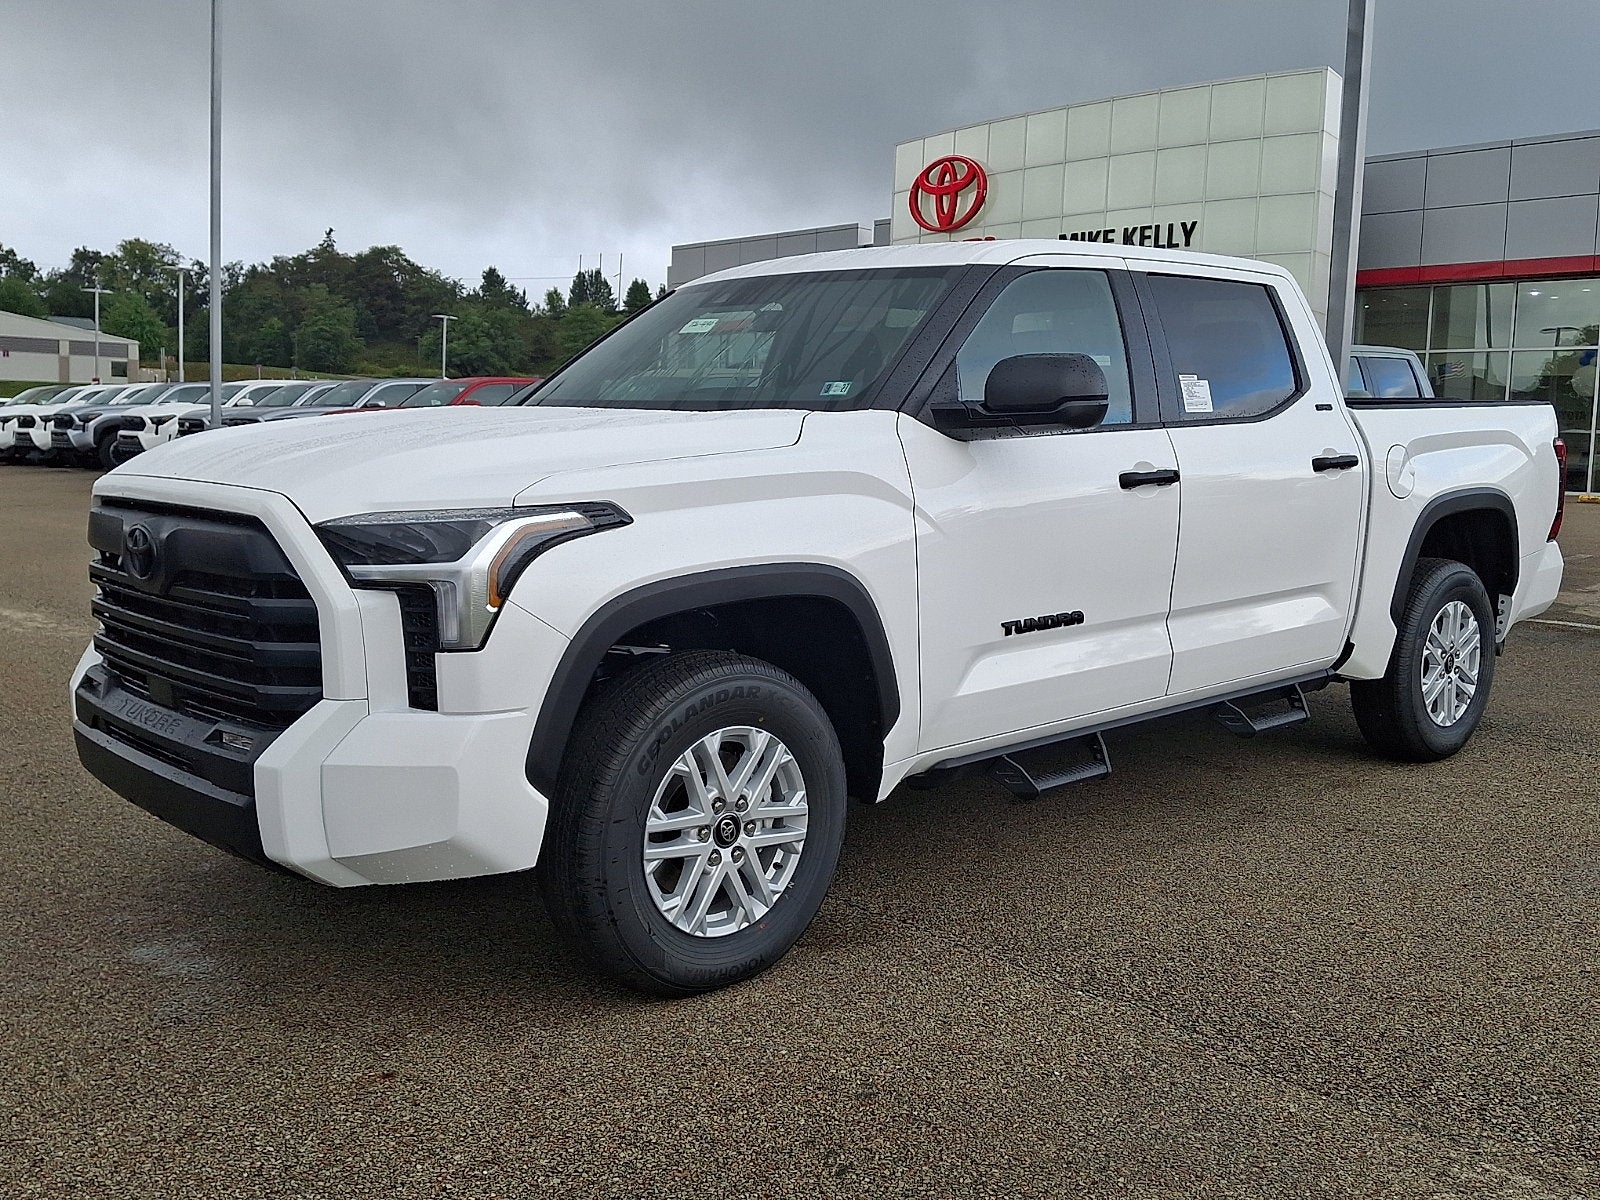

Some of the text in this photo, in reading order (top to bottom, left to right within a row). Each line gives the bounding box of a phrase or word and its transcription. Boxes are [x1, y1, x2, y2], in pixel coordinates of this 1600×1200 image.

[1123, 221, 1198, 248] KELLY
[1001, 611, 1085, 636] TUNDRA
[637, 686, 762, 777] GEOLANDAR
